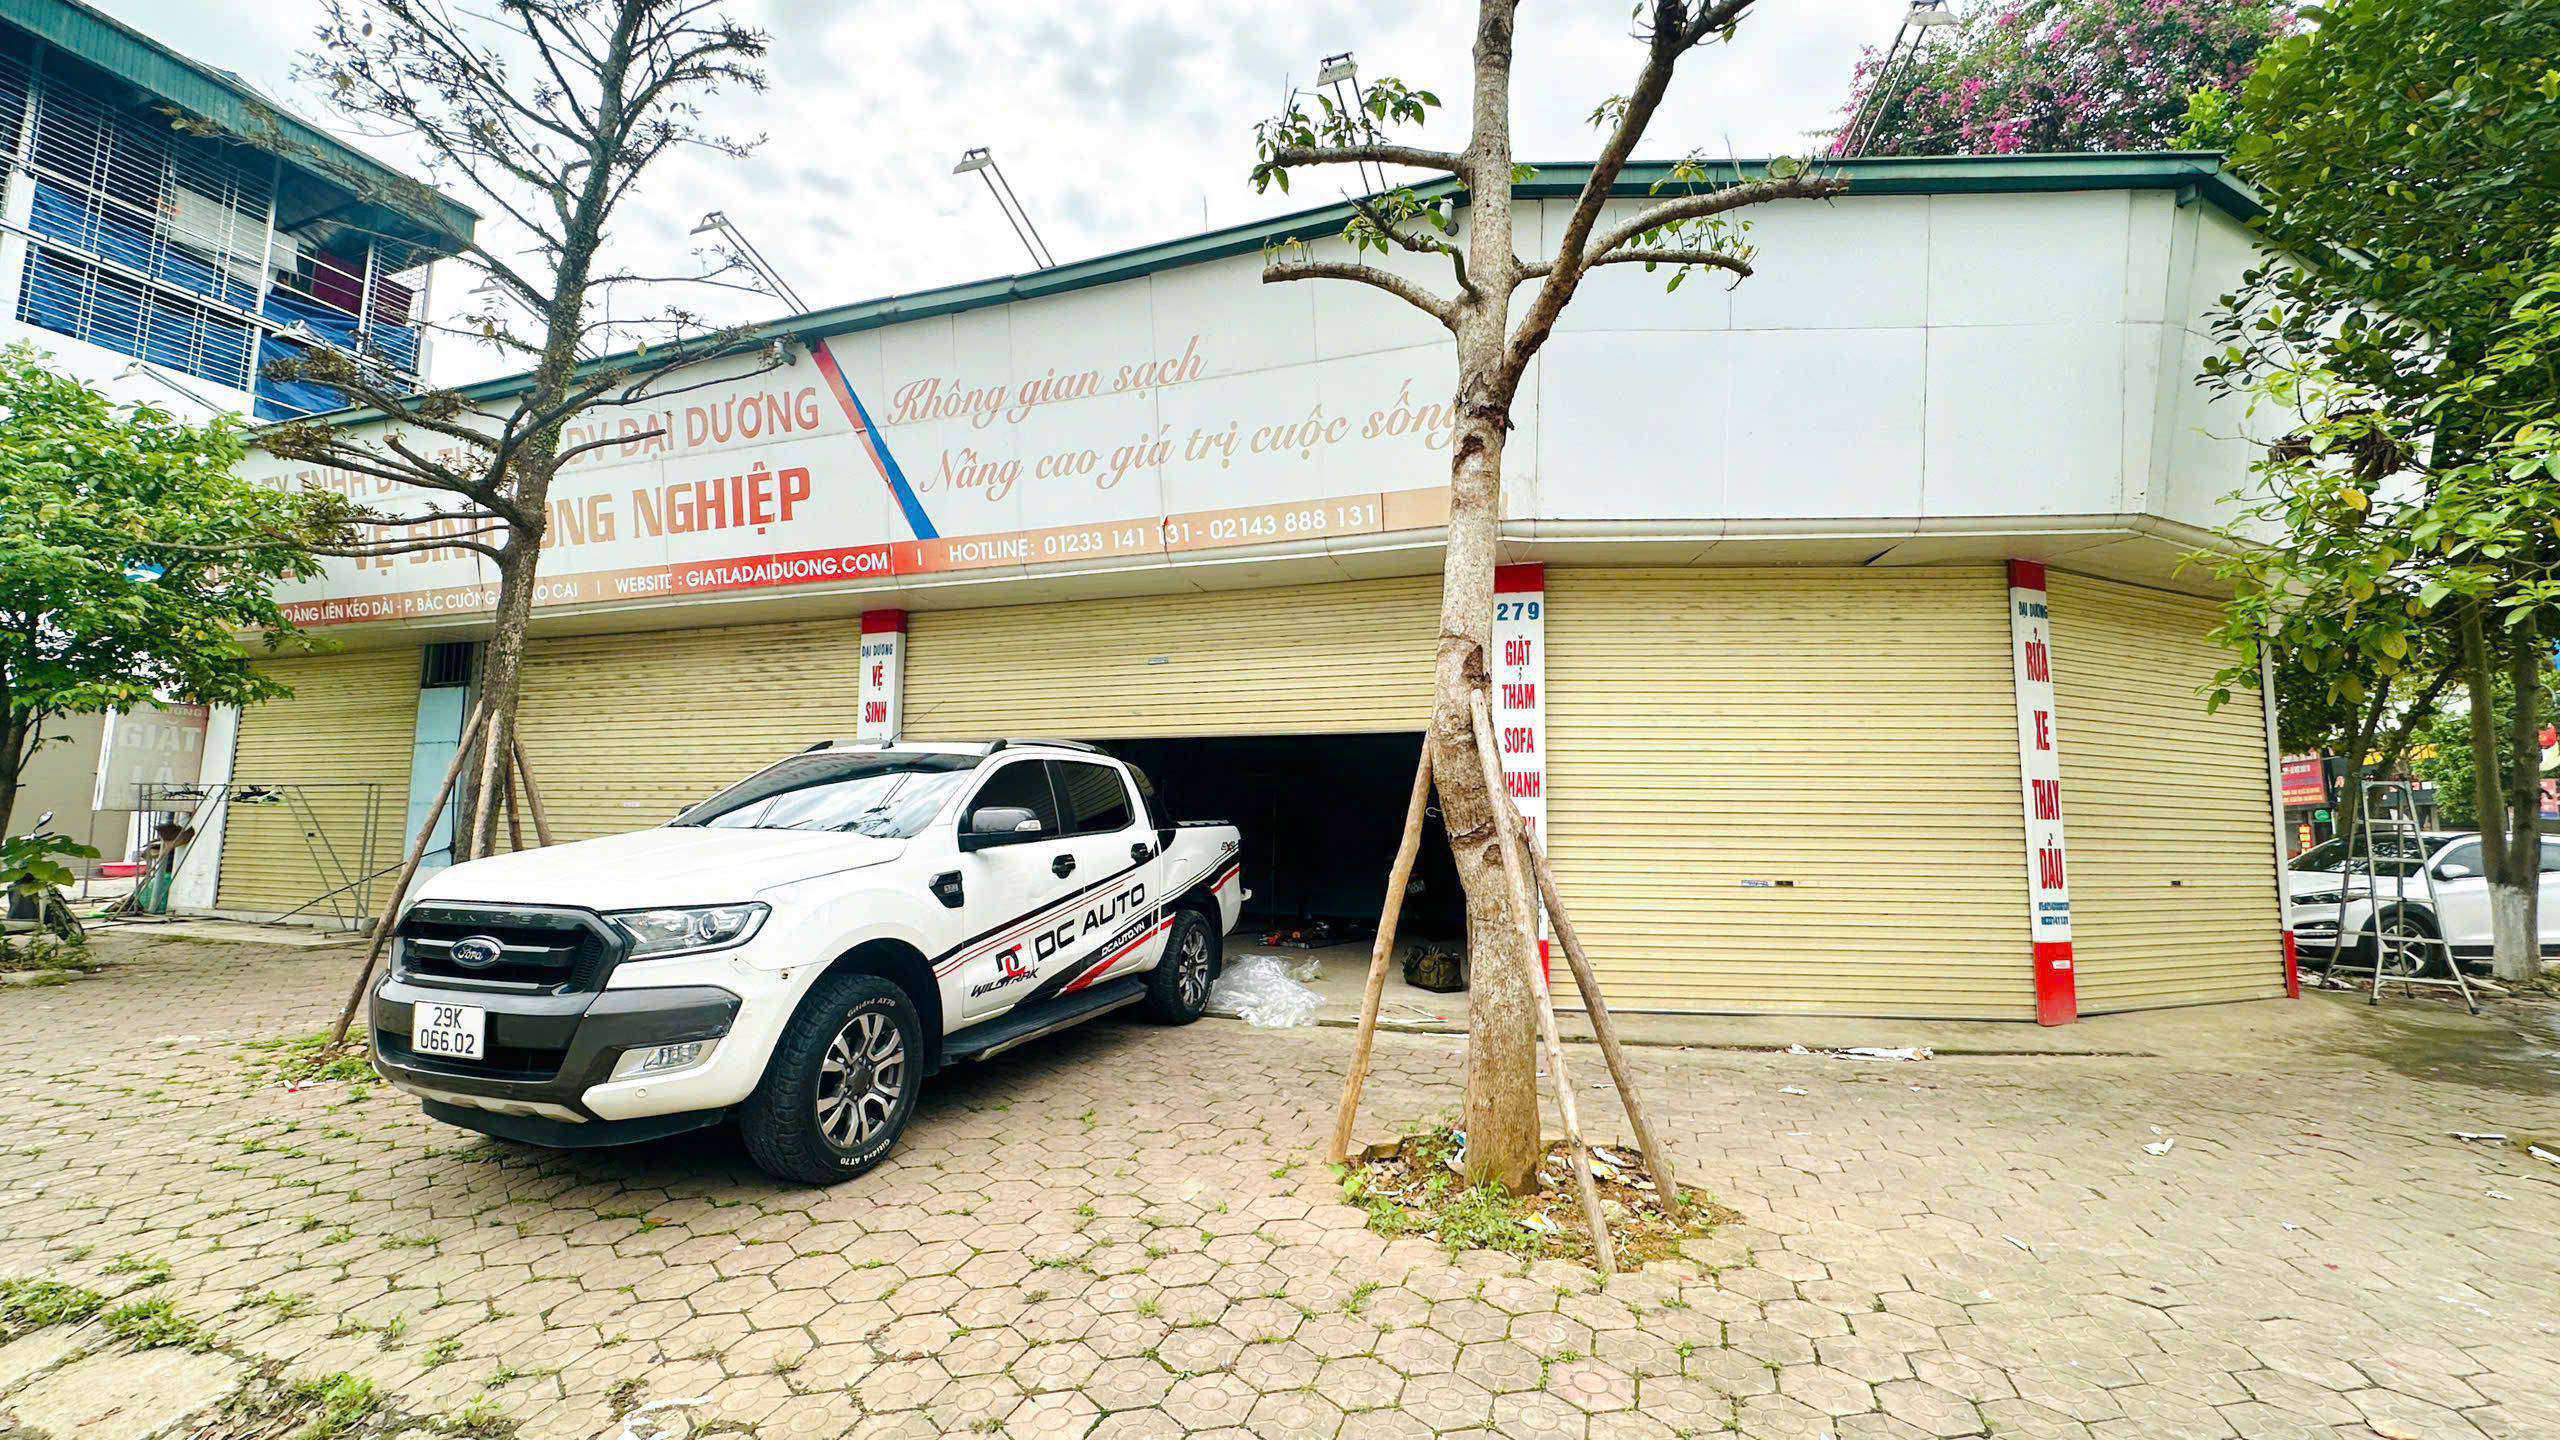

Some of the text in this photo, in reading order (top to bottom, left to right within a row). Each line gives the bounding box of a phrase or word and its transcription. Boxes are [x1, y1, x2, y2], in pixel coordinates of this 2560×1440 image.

[887, 334, 1208, 429] Không gian sạch
[686, 387, 819, 447] DƯƠNG
[920, 447, 1024, 501] Nâng
[1035, 448, 1102, 479] cao
[1095, 423, 1176, 489] giá
[1184, 420, 1242, 469] trị
[1250, 403, 1351, 460] cuộc
[632, 461, 811, 539] NGHIỆP
[372, 596, 394, 616] DÀI
[552, 582, 578, 599] CAI
[614, 573, 672, 594] WEBSITE
[686, 551, 888, 588] GIATLADAIDUONG.COM
[948, 538, 1035, 563] HOTLINE:
[1044, 531, 1103, 555] 01233
[1112, 527, 1145, 549] 141
[1156, 522, 1190, 544] 131
[1210, 518, 1277, 541] 02143
[1284, 510, 1326, 533] 888
[1336, 504, 1376, 528] 131
[1496, 602, 1540, 620] 279
[1505, 634, 1531, 670] GIẶT
[865, 701, 887, 723] SINH
[2033, 710, 2050, 750] XE
[1504, 727, 1534, 753] SOFA
[2032, 780, 2059, 820] THAY
[1082, 883, 1145, 936] AUTO
[457, 947, 483, 961] Ford
[434, 1007, 463, 1029] 29K
[421, 1029, 474, 1054] 066.02
